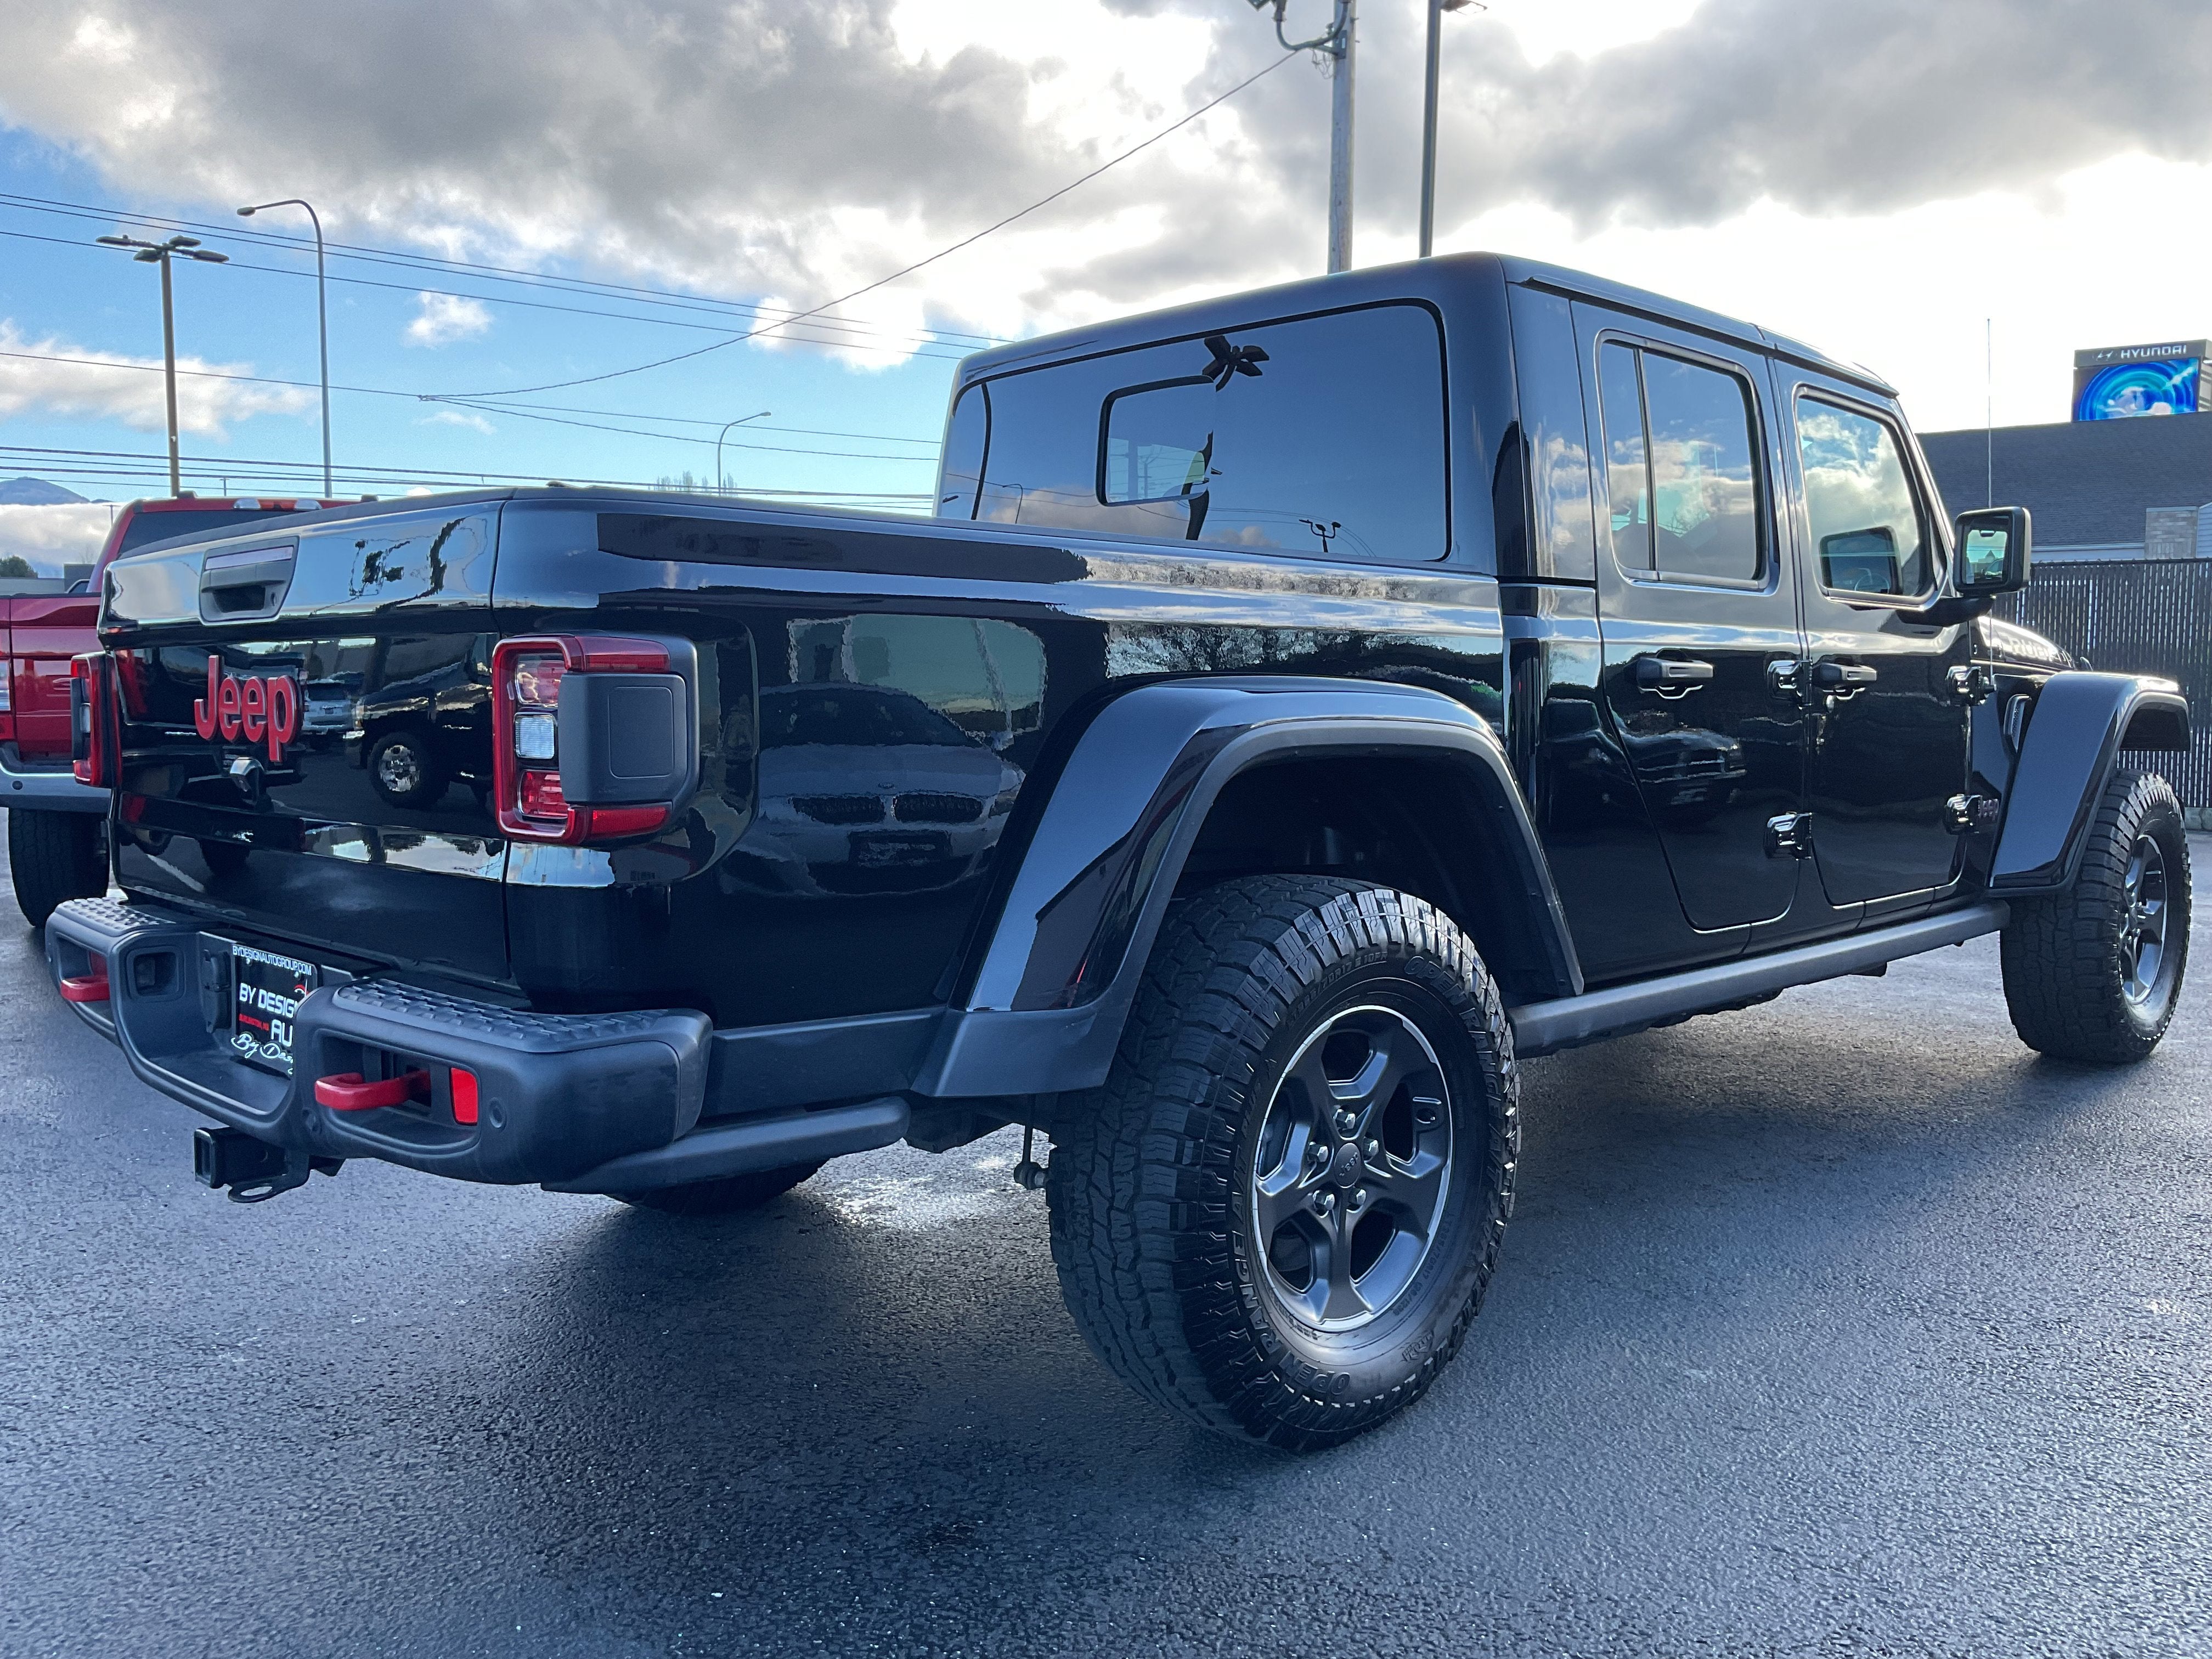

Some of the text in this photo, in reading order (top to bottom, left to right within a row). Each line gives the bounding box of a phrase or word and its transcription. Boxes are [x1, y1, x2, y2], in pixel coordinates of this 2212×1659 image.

[2121, 345, 2187, 359] HYUNDAI
[194, 654, 297, 763] Jeep
[233, 945, 312, 976] BYDESIGNAUTOGROUP.COM
[239, 983, 298, 1018] BY DESIG
[230, 1033, 259, 1059] By
[1404, 955, 1469, 1006] OPEN
[1458, 1007, 1503, 1120] RANGE
[1232, 1229, 1284, 1356] RANGE
[1278, 1350, 1351, 1396] OPEN
